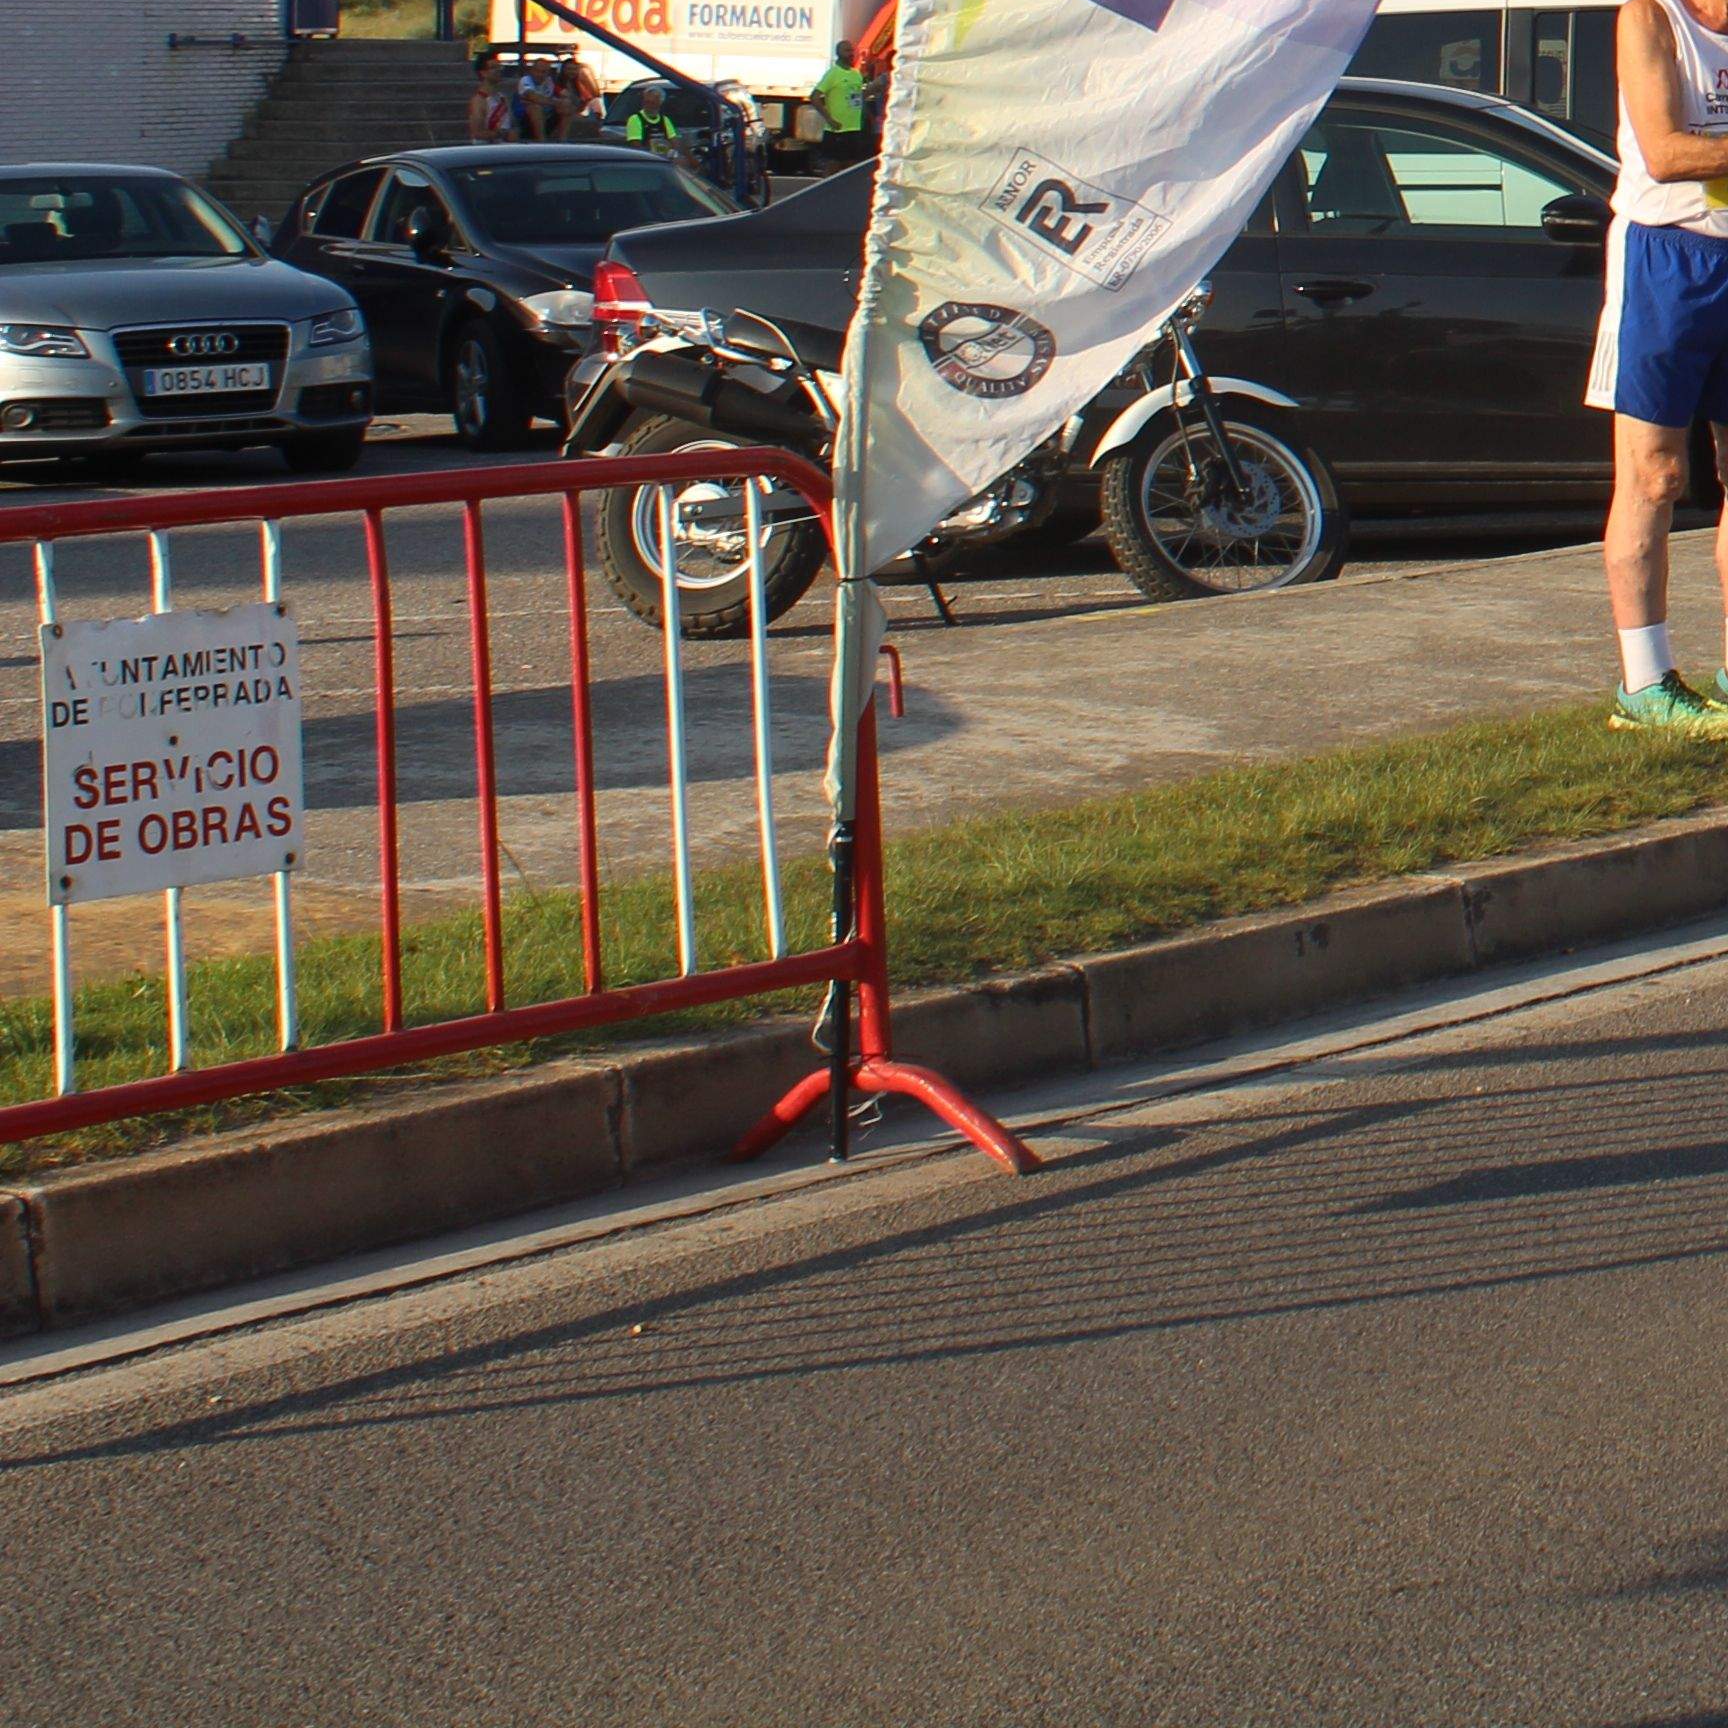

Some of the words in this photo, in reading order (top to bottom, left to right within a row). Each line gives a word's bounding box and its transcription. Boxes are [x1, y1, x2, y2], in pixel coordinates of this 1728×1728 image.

[688, 3, 813, 30] FORMACION
[161, 369, 217, 392] 0854
[223, 366, 265, 388] HCJ
[51, 698, 89, 728] DE
[74, 744, 280, 810] SERVICIO
[65, 818, 122, 865] DE
[138, 796, 292, 855] OBRAS
